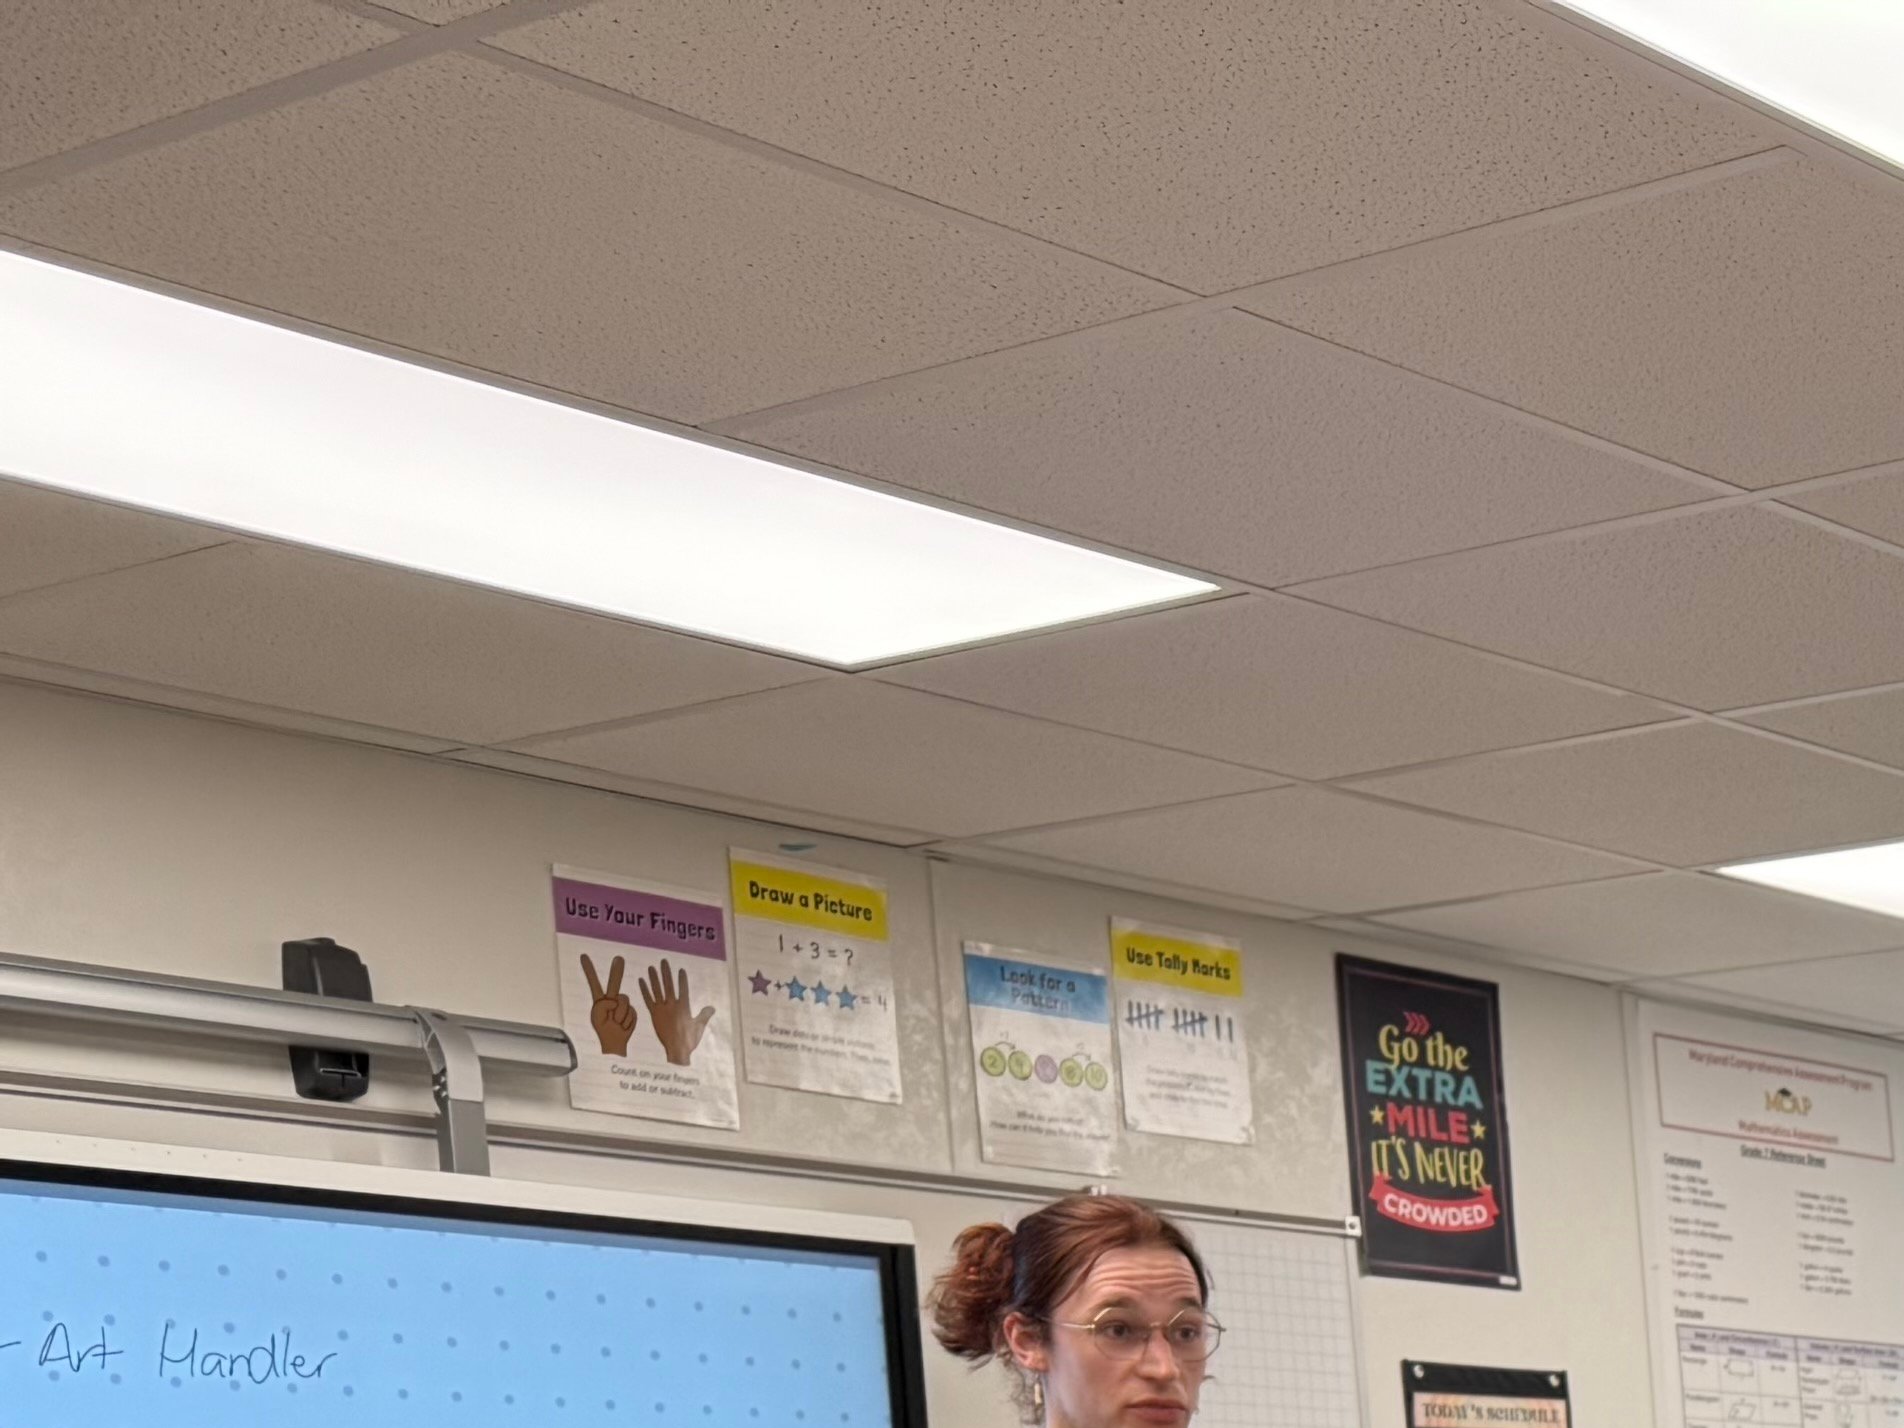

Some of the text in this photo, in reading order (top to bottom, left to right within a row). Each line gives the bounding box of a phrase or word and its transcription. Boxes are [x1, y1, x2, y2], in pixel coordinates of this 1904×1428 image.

[565, 897, 717, 941] Use Your Fingers
[749, 880, 874, 922] Draw a Picture
[1000, 966, 1076, 993] Look for a
[1126, 947, 1232, 980] Use Tally Marks
[1378, 1024, 1470, 1071] Go the
[1364, 1059, 1484, 1110] EXTRA
[1386, 1102, 1472, 1145] MILE
[1370, 1136, 1488, 1192] IT'S NEVER
[1382, 1192, 1488, 1228] CROWDED
[39, 1322, 338, 1384] Art Handler
